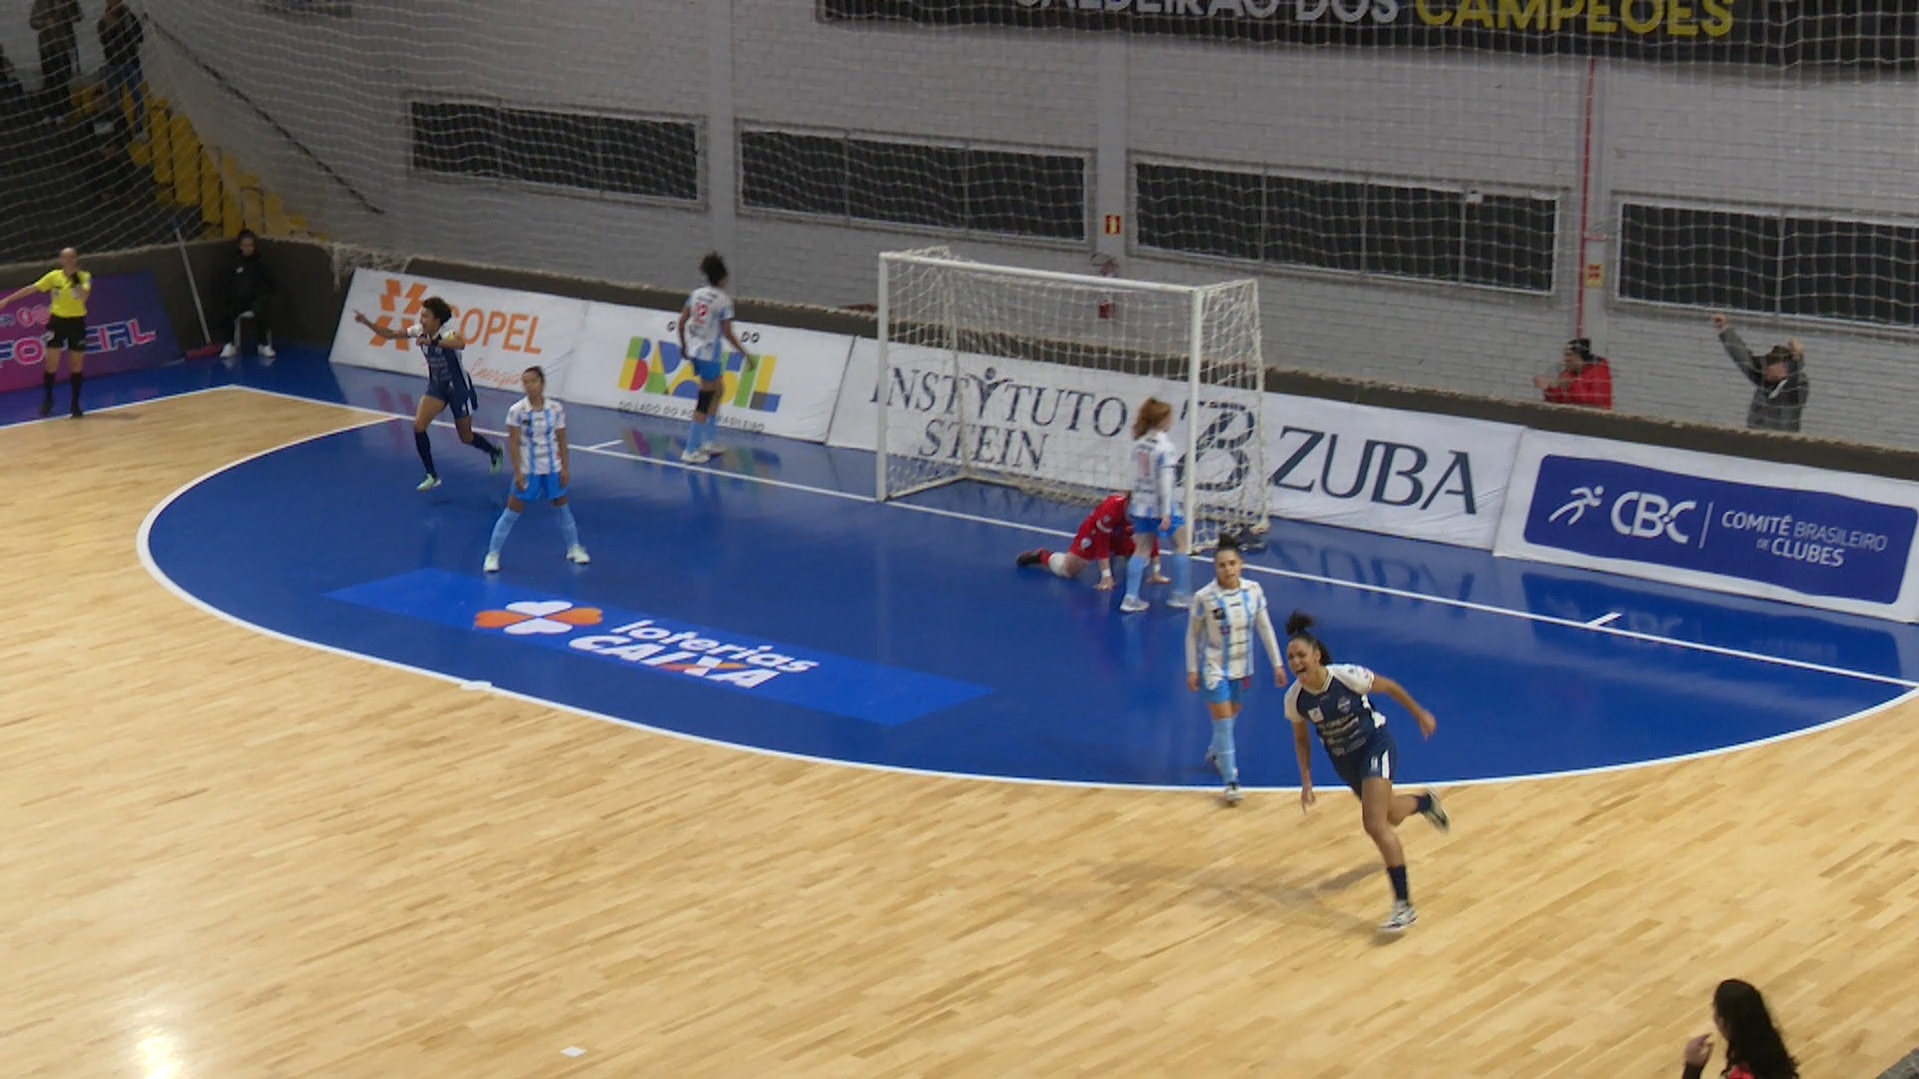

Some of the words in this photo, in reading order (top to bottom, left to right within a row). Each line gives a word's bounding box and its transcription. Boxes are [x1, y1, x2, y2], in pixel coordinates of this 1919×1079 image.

[1295, 0, 1398, 23] DOS
[448, 303, 542, 355] OPEL
[918, 418, 1049, 470] STEIN
[1269, 425, 1478, 515] ZUBA
[1610, 491, 1697, 544] CBC
[1721, 509, 1793, 536] COMITÊ
[1793, 521, 1889, 553] BRASILEIRO
[1770, 538, 1846, 567] CLUBES
[568, 635, 781, 688] CAIXA
[610, 619, 820, 673] loterias
